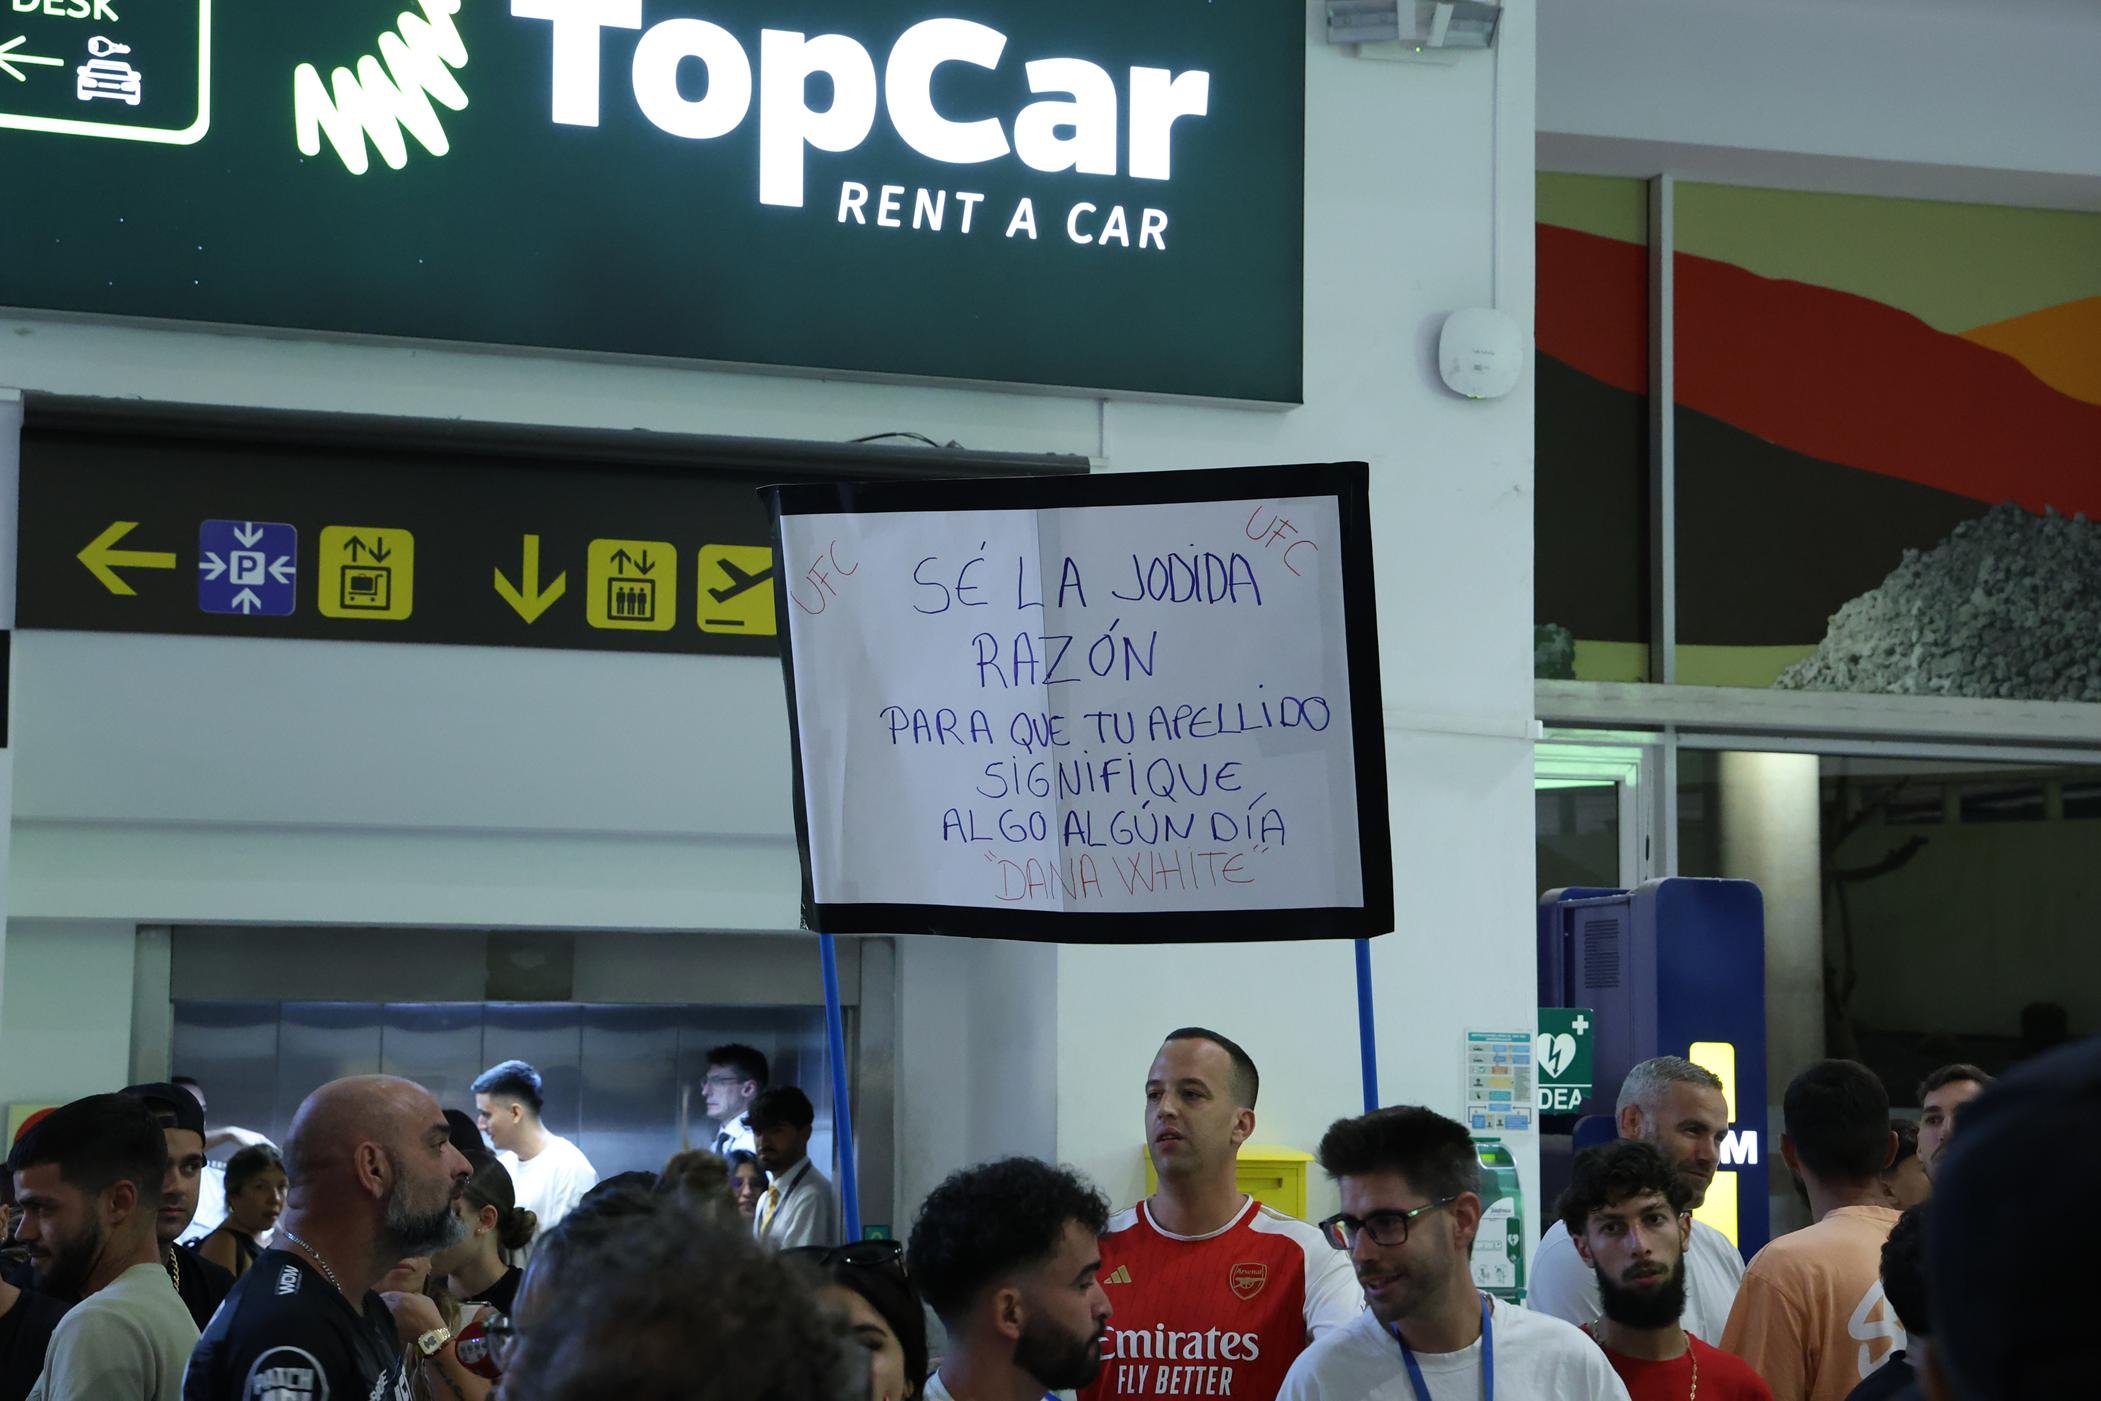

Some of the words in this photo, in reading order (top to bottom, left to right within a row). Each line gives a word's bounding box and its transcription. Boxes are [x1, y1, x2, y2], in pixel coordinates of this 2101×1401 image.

[511, 0, 1210, 207] TopCar
[838, 181, 985, 234] RENT
[1005, 197, 1038, 240] A
[1066, 202, 1168, 250] CAR
[1245, 505, 1319, 577] UFC
[790, 539, 859, 615] UFC
[913, 541, 989, 614] SÉ
[1017, 556, 1087, 608] LA
[972, 618, 1158, 689] RAZÓN
[880, 705, 994, 745] PARA
[1010, 712, 1071, 755] QUE
[1083, 710, 1135, 744] TU
[942, 807, 1047, 843] ALGO
[1063, 800, 1195, 847] ALGÚN
[1210, 791, 1285, 846] DÍA
[1537, 1088, 1583, 1110] DEA
[1117, 1365, 1149, 1395] FLY
[1154, 1364, 1234, 1396] BETTER
